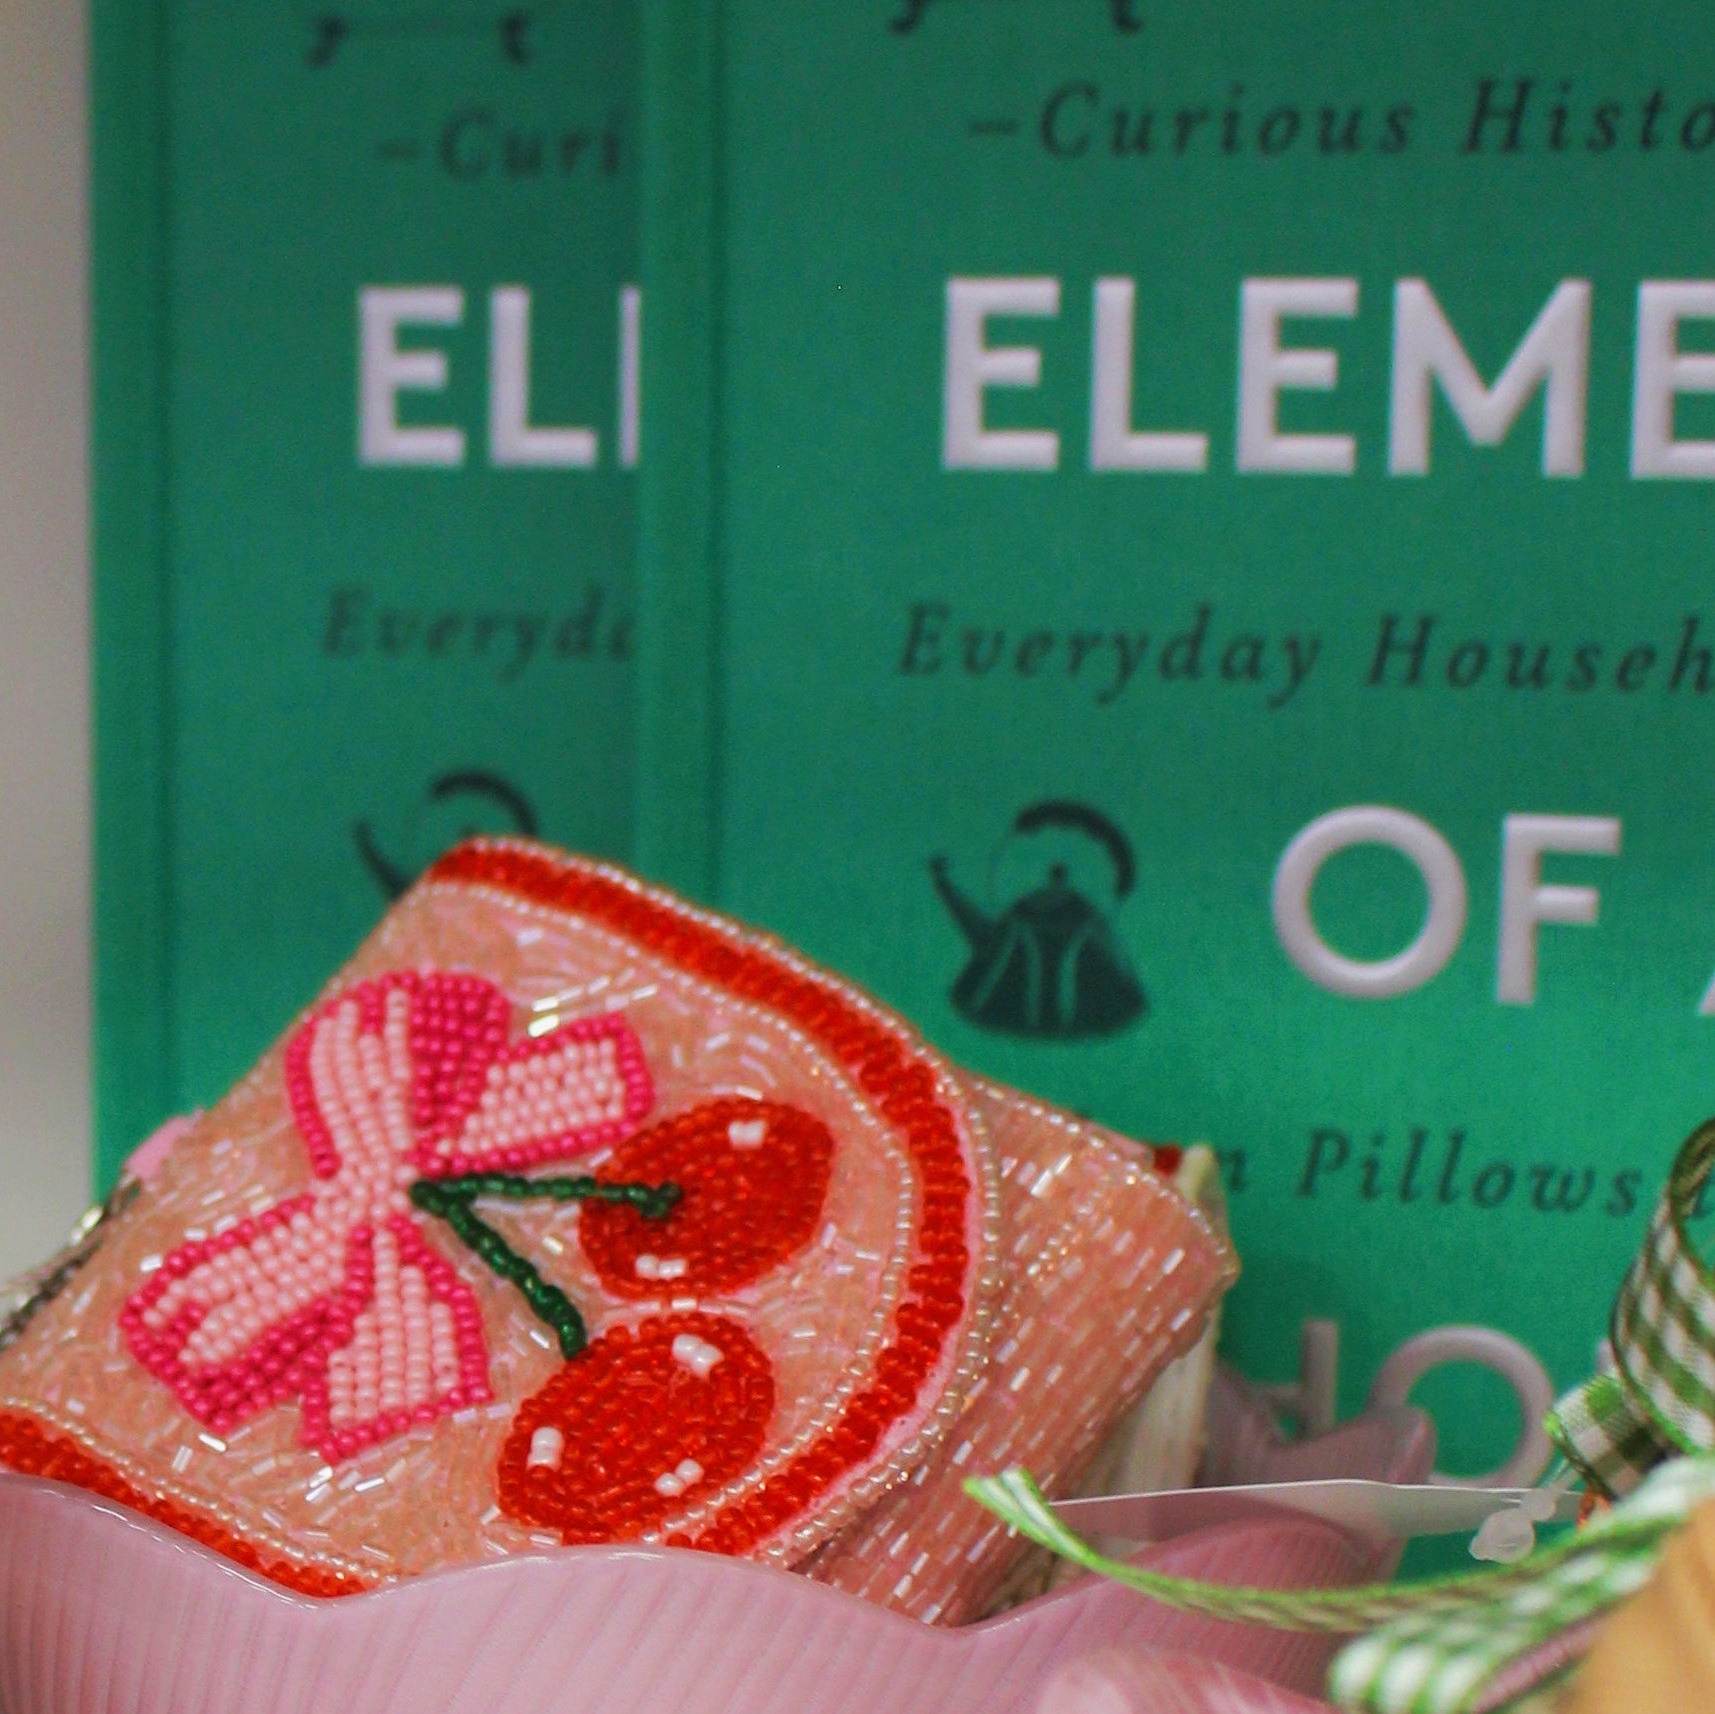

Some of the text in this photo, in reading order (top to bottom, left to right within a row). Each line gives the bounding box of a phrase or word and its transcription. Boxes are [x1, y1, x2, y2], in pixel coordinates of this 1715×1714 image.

[359, 286, 640, 468] EL
[942, 276, 1715, 478] ELEME
[898, 602, 1324, 710] Everyday
[1272, 805, 1622, 1006] OF
[1296, 1126, 1644, 1220] Pillows
